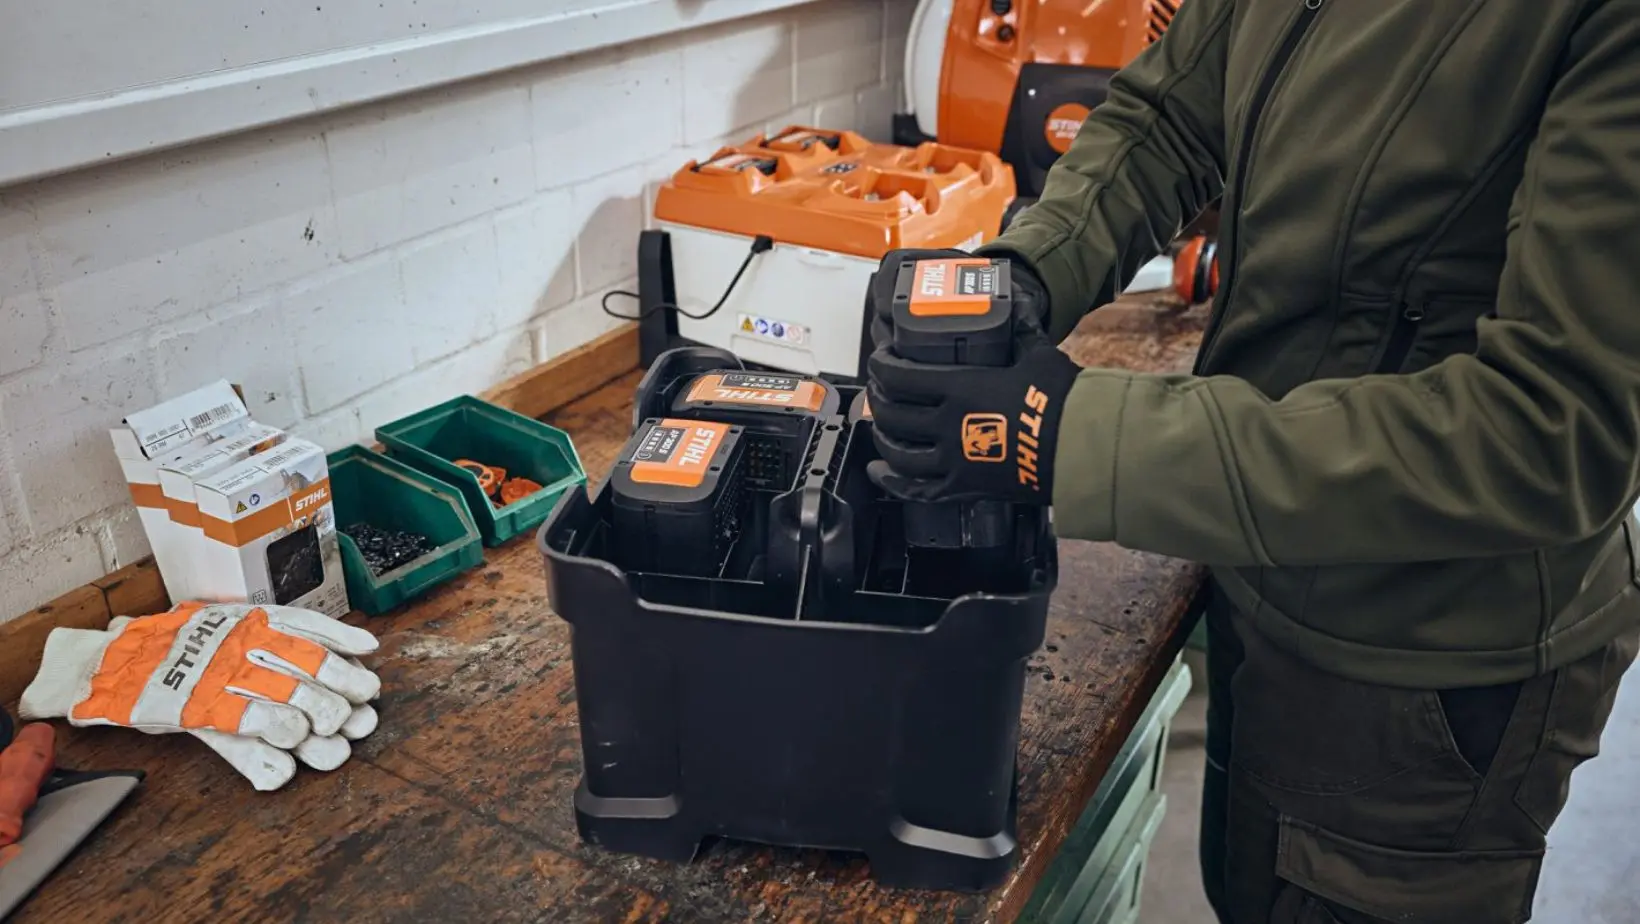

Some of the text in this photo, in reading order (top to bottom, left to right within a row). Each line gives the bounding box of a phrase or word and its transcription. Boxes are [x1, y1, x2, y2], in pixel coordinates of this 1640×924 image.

[921, 264, 946, 296] STIHL
[715, 388, 795, 403] STIHL
[679, 427, 715, 466] STIHL
[1017, 384, 1048, 485] STIHL
[295, 487, 328, 511] STIHL
[162, 615, 228, 691] STIHL
